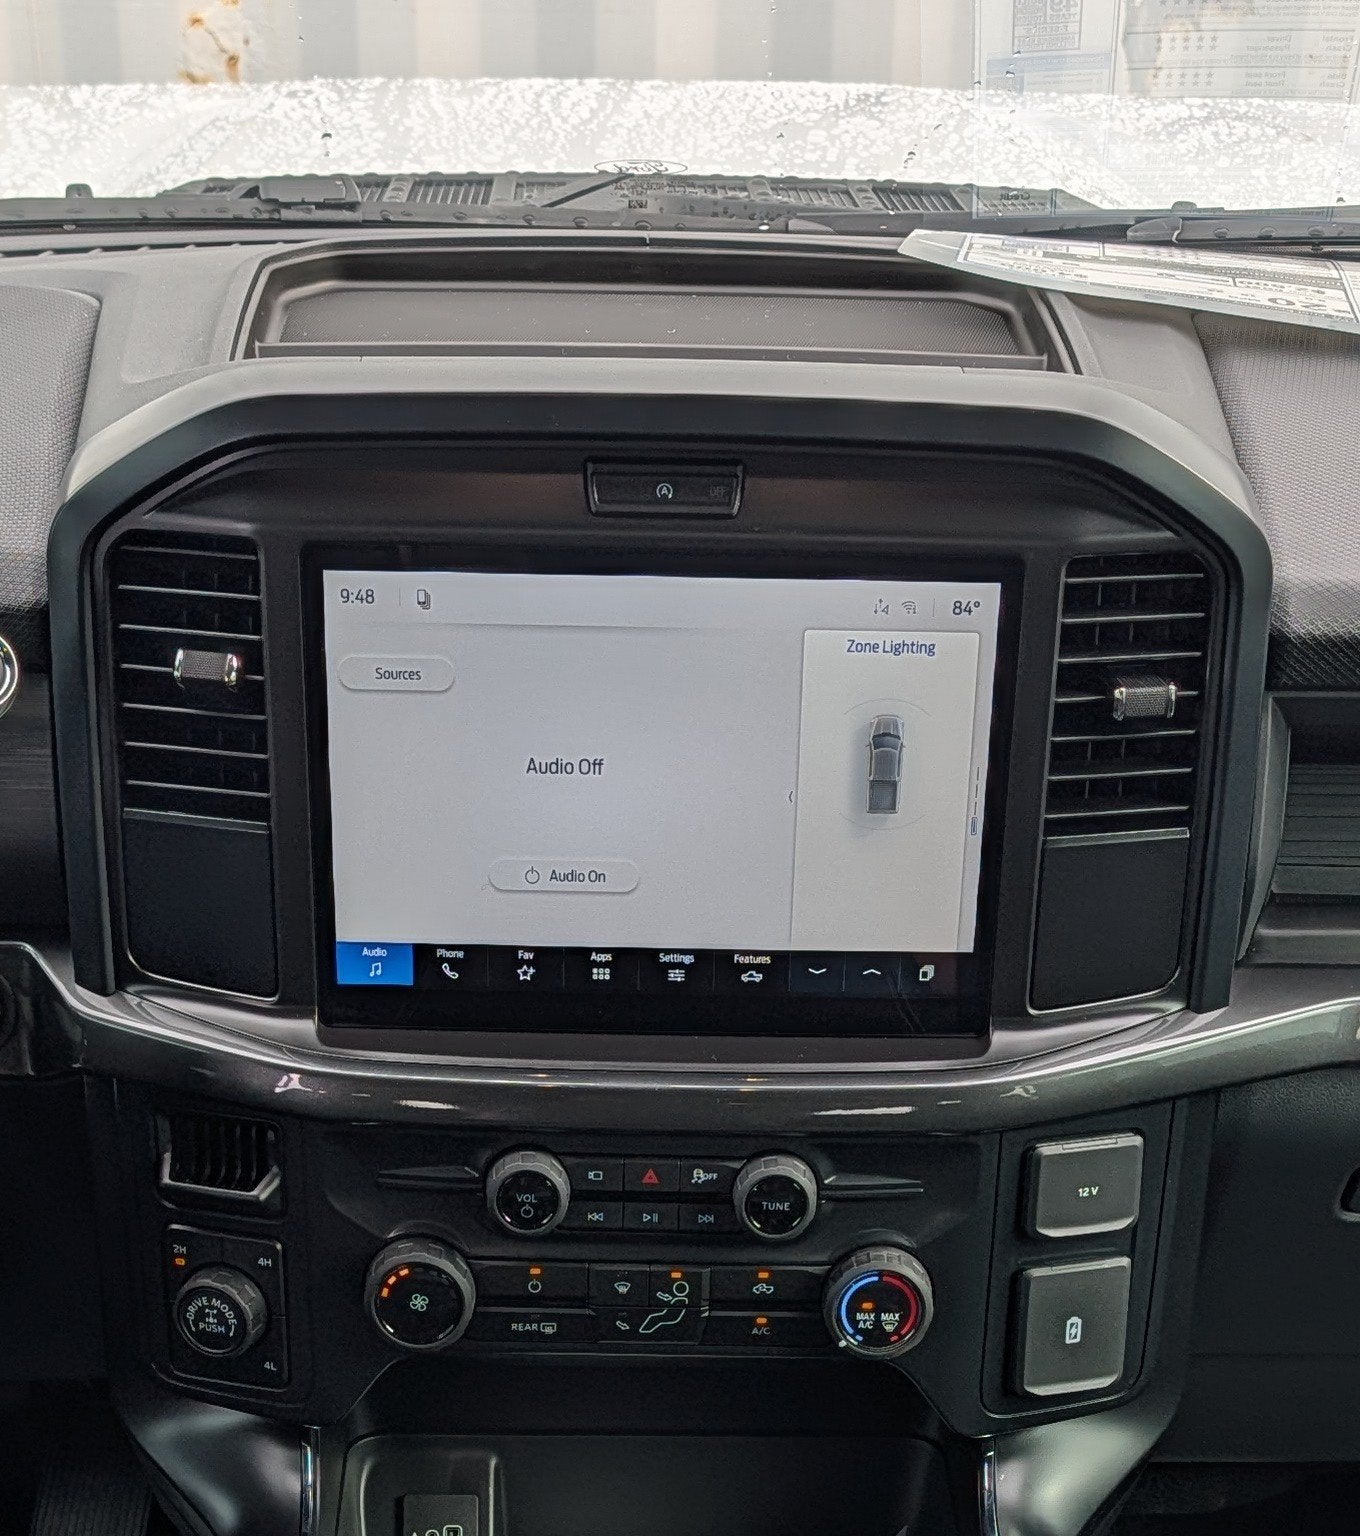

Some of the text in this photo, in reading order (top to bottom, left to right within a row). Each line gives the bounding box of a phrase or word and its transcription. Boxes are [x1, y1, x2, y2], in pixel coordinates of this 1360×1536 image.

[339, 588, 375, 605] 9:48
[952, 600, 981, 616] 84°
[846, 639, 936, 657] Zone Lighting
[375, 667, 422, 681] Sources
[525, 757, 605, 776] Audio Off
[548, 868, 607, 884] Audio On
[362, 946, 388, 957] Audio
[436, 948, 464, 959] Phone
[517, 950, 535, 960] Fav
[590, 951, 613, 963] Apps
[659, 952, 695, 964] Settings
[734, 953, 771, 964] Features
[703, 1172, 719, 1182] OFF
[1078, 1186, 1100, 1198] 12 V
[516, 1193, 538, 1203] VOL
[762, 1202, 791, 1212] TUNE
[172, 1244, 187, 1254] 2H
[257, 1257, 272, 1267] 4H
[186, 1296, 237, 1325] DRIVE MODE
[856, 1312, 875, 1321] MAX
[881, 1312, 900, 1321] MAX
[199, 1322, 225, 1333] PUSH
[511, 1323, 538, 1331] REAR
[858, 1320, 874, 1330] A/C
[751, 1327, 771, 1336] A/C
[263, 1361, 277, 1371] 4L
